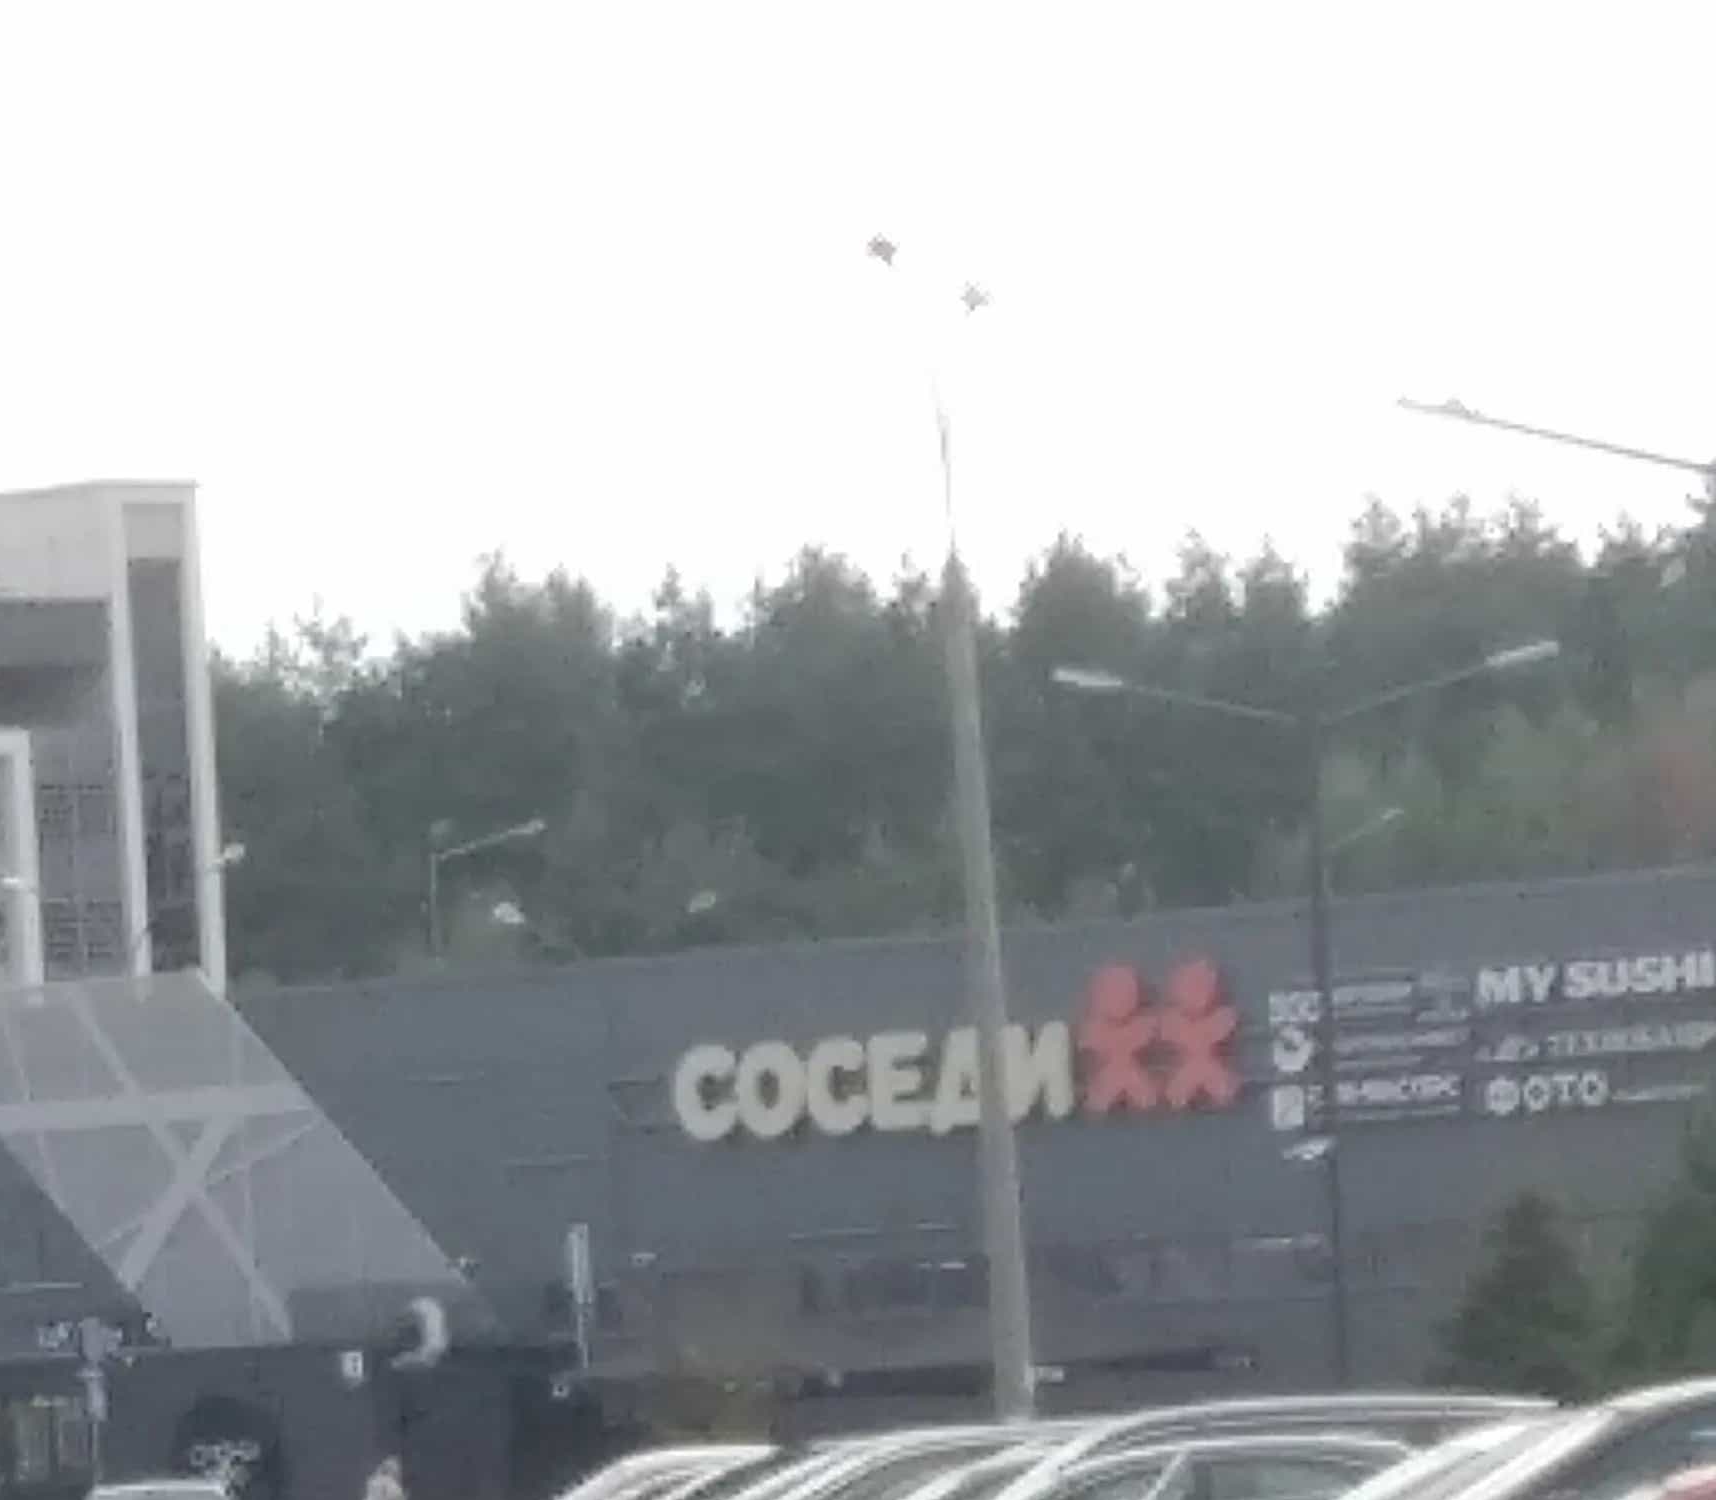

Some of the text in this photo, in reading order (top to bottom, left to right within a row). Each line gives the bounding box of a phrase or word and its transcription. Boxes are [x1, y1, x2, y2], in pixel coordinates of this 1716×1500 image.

[1478, 951, 1715, 1003] MY SUSHI
[675, 1020, 1073, 1140] СОСЕДИ
[1487, 1072, 1607, 1115] ФОТО
